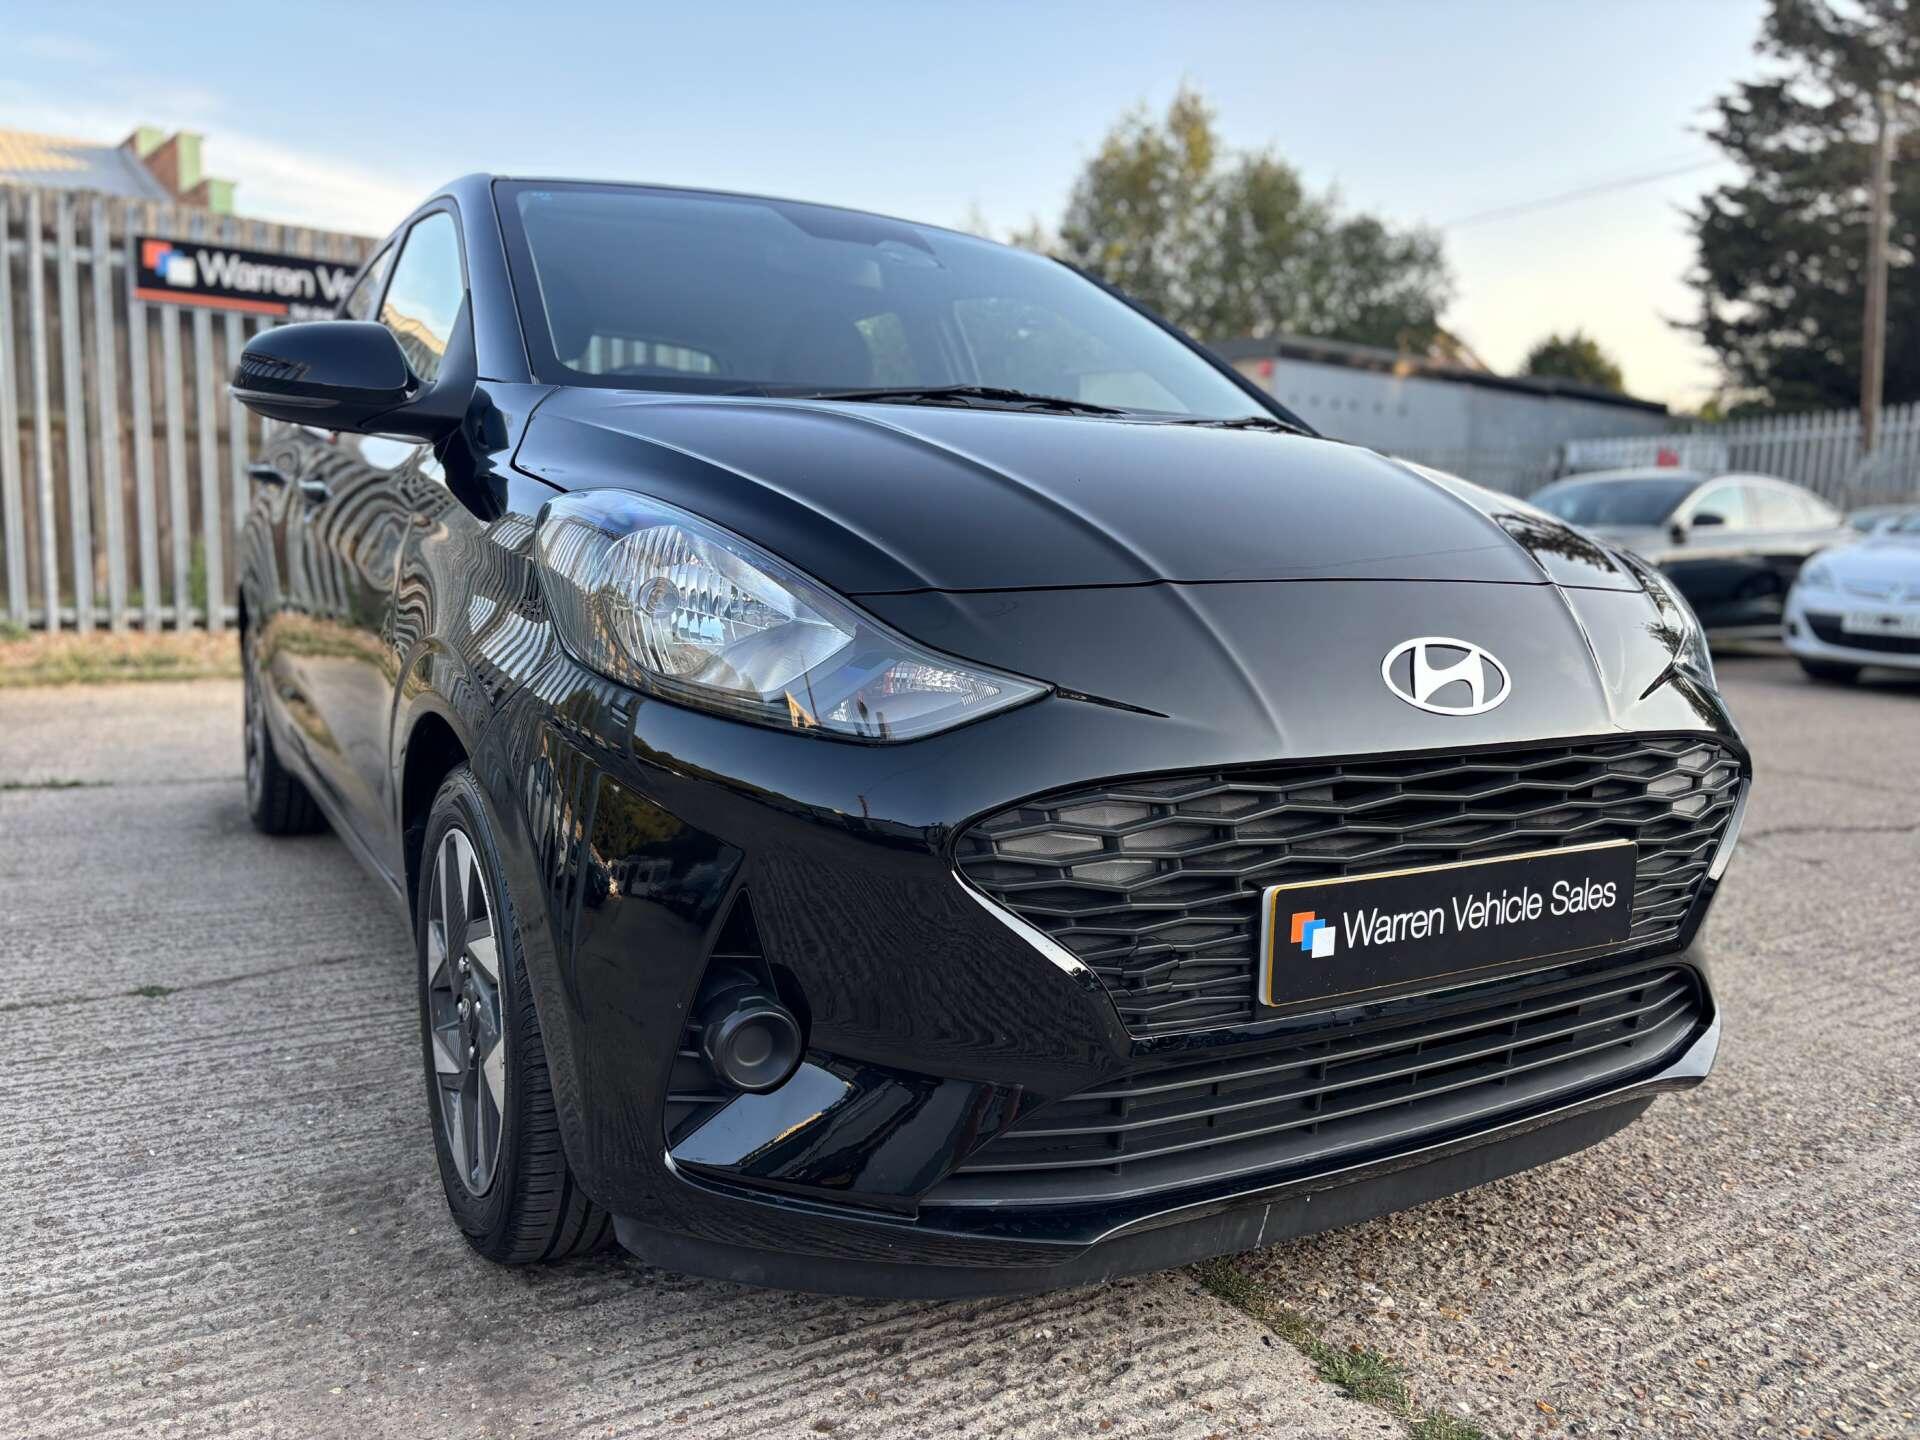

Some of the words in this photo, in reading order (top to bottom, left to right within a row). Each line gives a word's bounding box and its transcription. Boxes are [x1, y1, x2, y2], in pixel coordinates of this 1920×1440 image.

[197, 250, 316, 298] Warren
[1343, 907, 1444, 949] Warren
[1452, 886, 1542, 932] Vehicle
[1550, 877, 1617, 915] Sales
